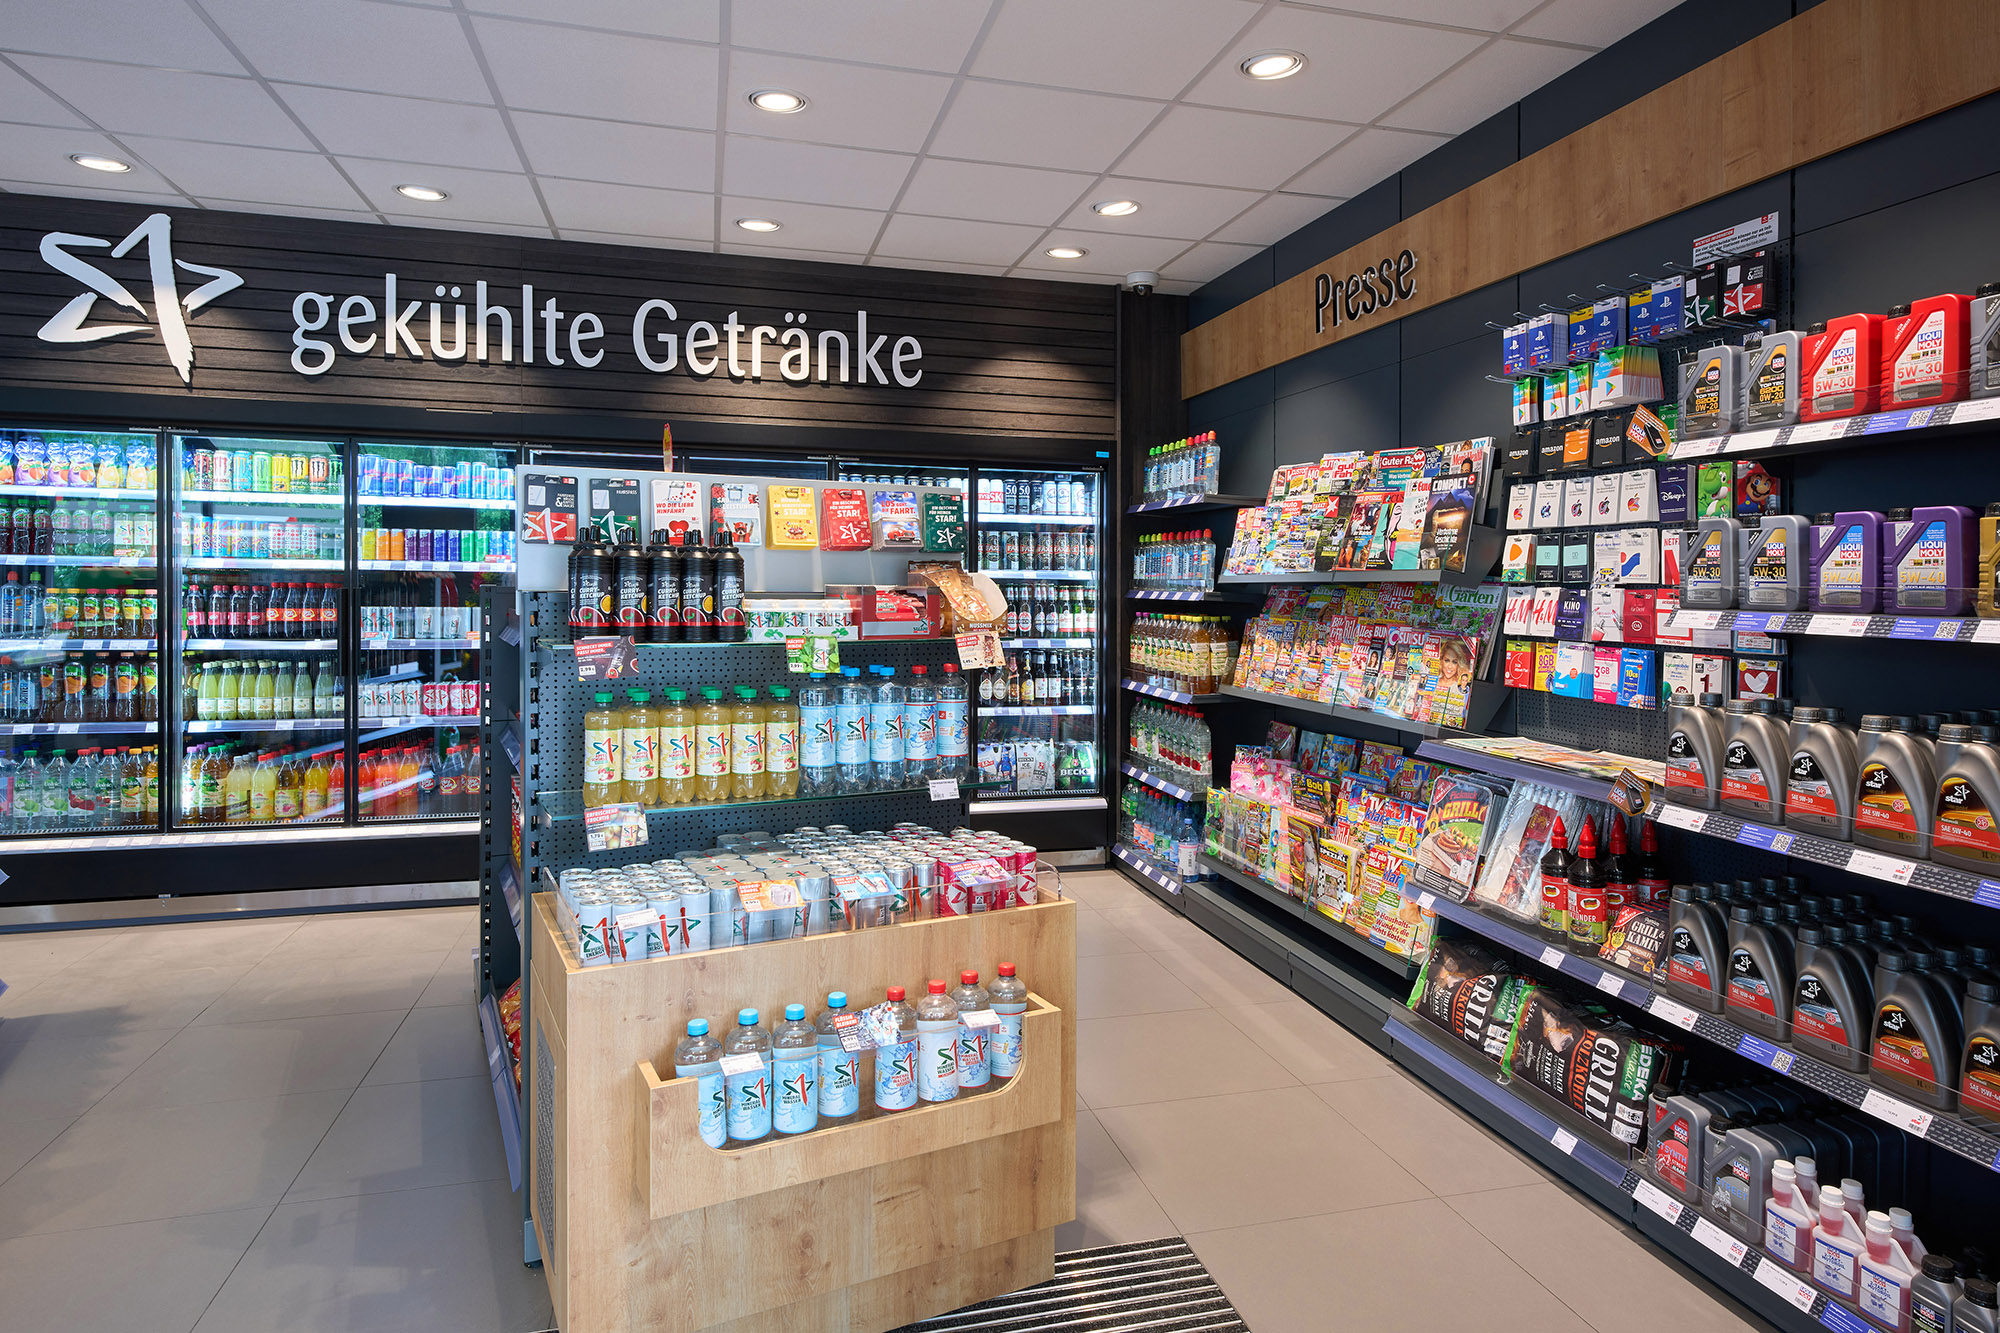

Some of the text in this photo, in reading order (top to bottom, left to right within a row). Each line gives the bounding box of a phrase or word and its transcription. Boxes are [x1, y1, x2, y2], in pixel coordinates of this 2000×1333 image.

[1315, 249, 1416, 335] Presse
[291, 272, 924, 389] gekühlte Getränke
[1918, 330, 1942, 343] LIQUI
[1918, 339, 1942, 350] MOLY
[1833, 347, 1854, 358] LIQUI
[1832, 356, 1854, 365] MOLY
[1897, 361, 1942, 379] 5W-30
[1815, 376, 1854, 392] 5W-30
[1760, 392, 1784, 402] 0W-20
[1695, 402, 1718, 412] 0W-20
[1595, 435, 1620, 446] amazon
[1509, 449, 1529, 457] amazon
[1541, 444, 1563, 454] amazon
[1382, 456, 1403, 466] Guter
[1432, 477, 1468, 492] COMPACT
[1660, 491, 1686, 502] Disney+
[836, 510, 860, 518] STAR!
[890, 507, 916, 515] FAHRT.
[934, 514, 957, 522] STAR!
[1840, 543, 1861, 551] LIQUI
[1919, 540, 1944, 549] LIQUI
[1840, 551, 1861, 559] MOLY
[1919, 549, 1944, 557] MOLY
[1693, 566, 1720, 577] 5W-30
[1753, 566, 1786, 577] 5W-30
[1823, 571, 1861, 583] 5W-40
[1900, 571, 1945, 584] 5W-40
[1449, 585, 1494, 605] Garten
[1505, 598, 1529, 625] H&M
[1563, 601, 1581, 610] KINO
[1532, 599, 1558, 626] H&M
[1538, 655, 1554, 666] 8GB
[1594, 665, 1610, 679] 3 GB
[1306, 778, 1323, 791] Bob
[1865, 780, 1882, 789] star
[1449, 790, 1477, 800] Picknick
[1945, 794, 1963, 805] star
[1370, 796, 1386, 812] TV
[1442, 801, 1480, 819] GRILL
[1862, 808, 1890, 819] SAE 5W-40
[1941, 824, 1972, 837] SAE 5W-40
[1387, 853, 1403, 873] TV
[1383, 867, 1401, 884] klar
[1380, 912, 1411, 930] Haushalts-
[1376, 919, 1409, 937] Wunder, die
[1631, 920, 1660, 940] GRILL
[1387, 933, 1406, 944] kosten
[1625, 930, 1661, 953] KAMIN
[1463, 974, 1498, 1041] GRILL
[1883, 1020, 1900, 1031] star
[1879, 1047, 1910, 1065] SAE 15W-40
[1573, 1028, 1598, 1114] HOLZKOHLE
[1631, 1044, 1654, 1101] EDEKA
[1584, 1037, 1620, 1123] GRILL
[1656, 1139, 1687, 1164] 2T SYNTH
[1733, 1160, 1750, 1174] LIQUI
[1733, 1166, 1749, 1180] MOLY
[1716, 1176, 1748, 1201] STREET
